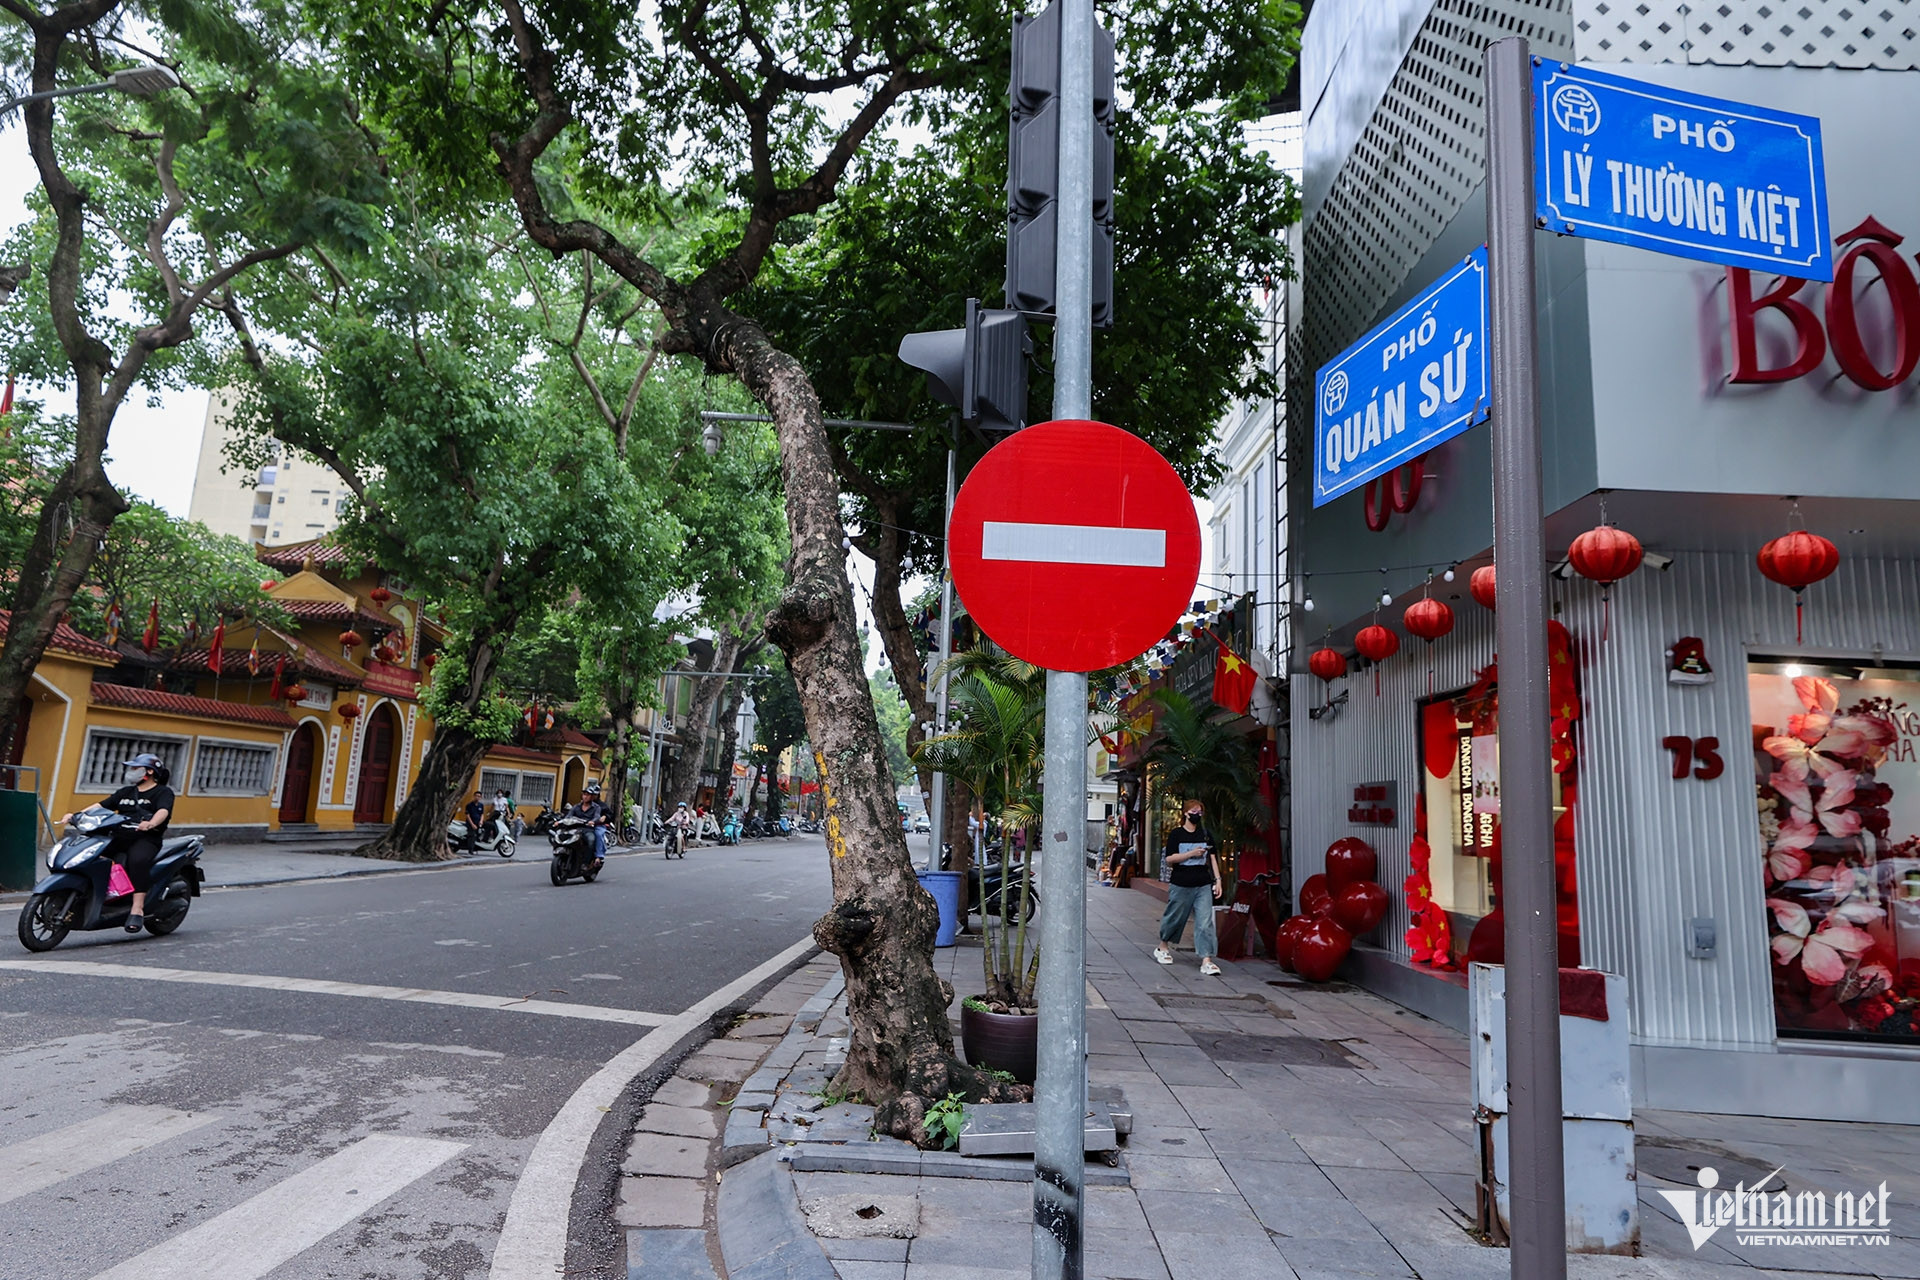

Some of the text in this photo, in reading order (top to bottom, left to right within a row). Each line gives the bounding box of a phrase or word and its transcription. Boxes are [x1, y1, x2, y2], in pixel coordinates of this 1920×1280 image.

[1653, 113, 1736, 153] PHỐ
[1563, 143, 1800, 254] LÝ THƯỜNG KIỆT
[1383, 299, 1440, 372] PHỐ
[1326, 328, 1473, 474] QUÁN SỨ
[1461, 736, 1474, 846] BONGCHA BONGCHA
[1662, 736, 1724, 780] 75
